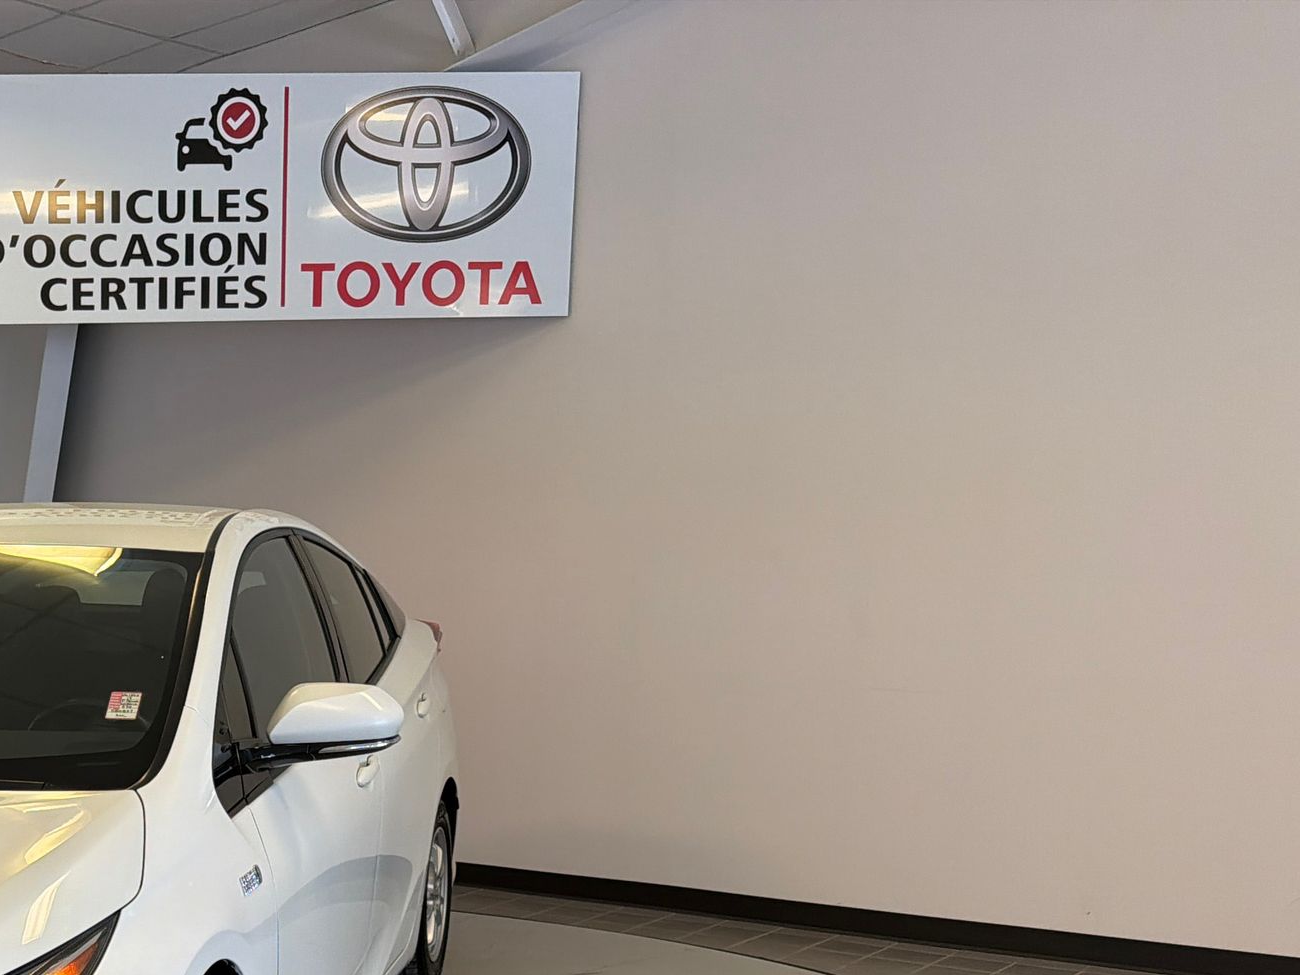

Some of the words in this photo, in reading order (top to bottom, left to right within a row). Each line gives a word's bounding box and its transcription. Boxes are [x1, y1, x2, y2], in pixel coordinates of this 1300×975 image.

[12, 178, 269, 225] VÉHICULES
[40, 264, 268, 312] CERTIFIÉS
[300, 260, 542, 308] TOYOTA
